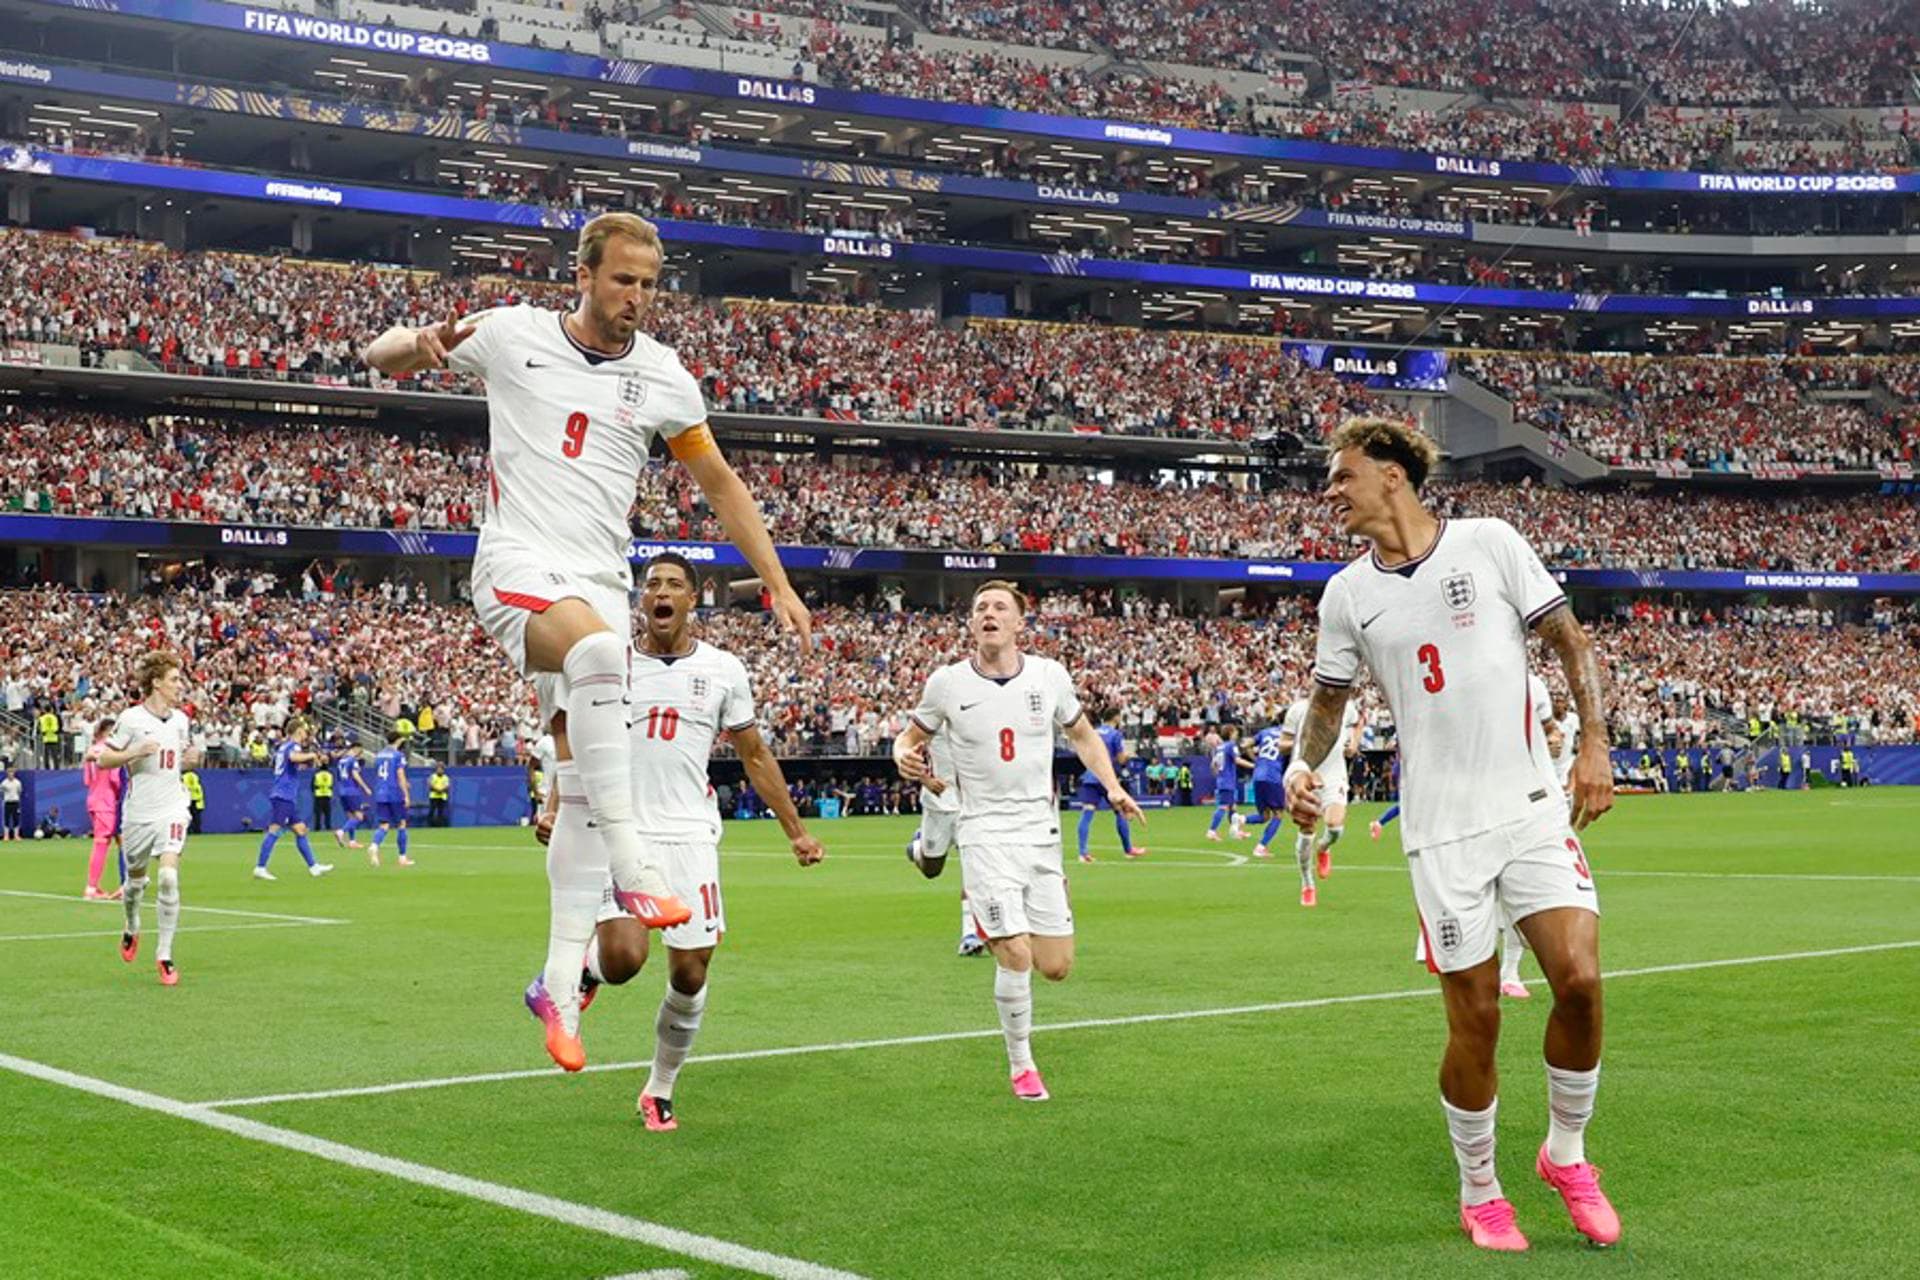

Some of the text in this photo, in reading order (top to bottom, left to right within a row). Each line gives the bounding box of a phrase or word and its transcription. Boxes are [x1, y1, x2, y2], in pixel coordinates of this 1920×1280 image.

[244, 10, 490, 61] FIFA WORLD CUP 2026
[738, 79, 815, 104] DALLAS
[1436, 157, 1500, 176] DALLAS
[1700, 174, 1896, 191] FIFA WORLD CUP 2026
[1038, 186, 1119, 204] DALLAS
[1328, 213, 1464, 234] FIFA WORLD CUP 2026
[823, 238, 892, 257] DALLAS
[1250, 273, 1416, 299] FIFA WORLD CUP 2026
[1748, 300, 1813, 313] DALLAS
[1334, 357, 1397, 375] DALLAS
[561, 411, 589, 459] 9
[221, 528, 288, 545] DALLAS
[1417, 644, 1445, 694] 3
[647, 706, 679, 740] 10
[999, 727, 1015, 762] 8
[1260, 736, 1280, 760] 26
[159, 749, 175, 769] 18
[378, 760, 388, 781] 4
[1565, 838, 1589, 879] 3
